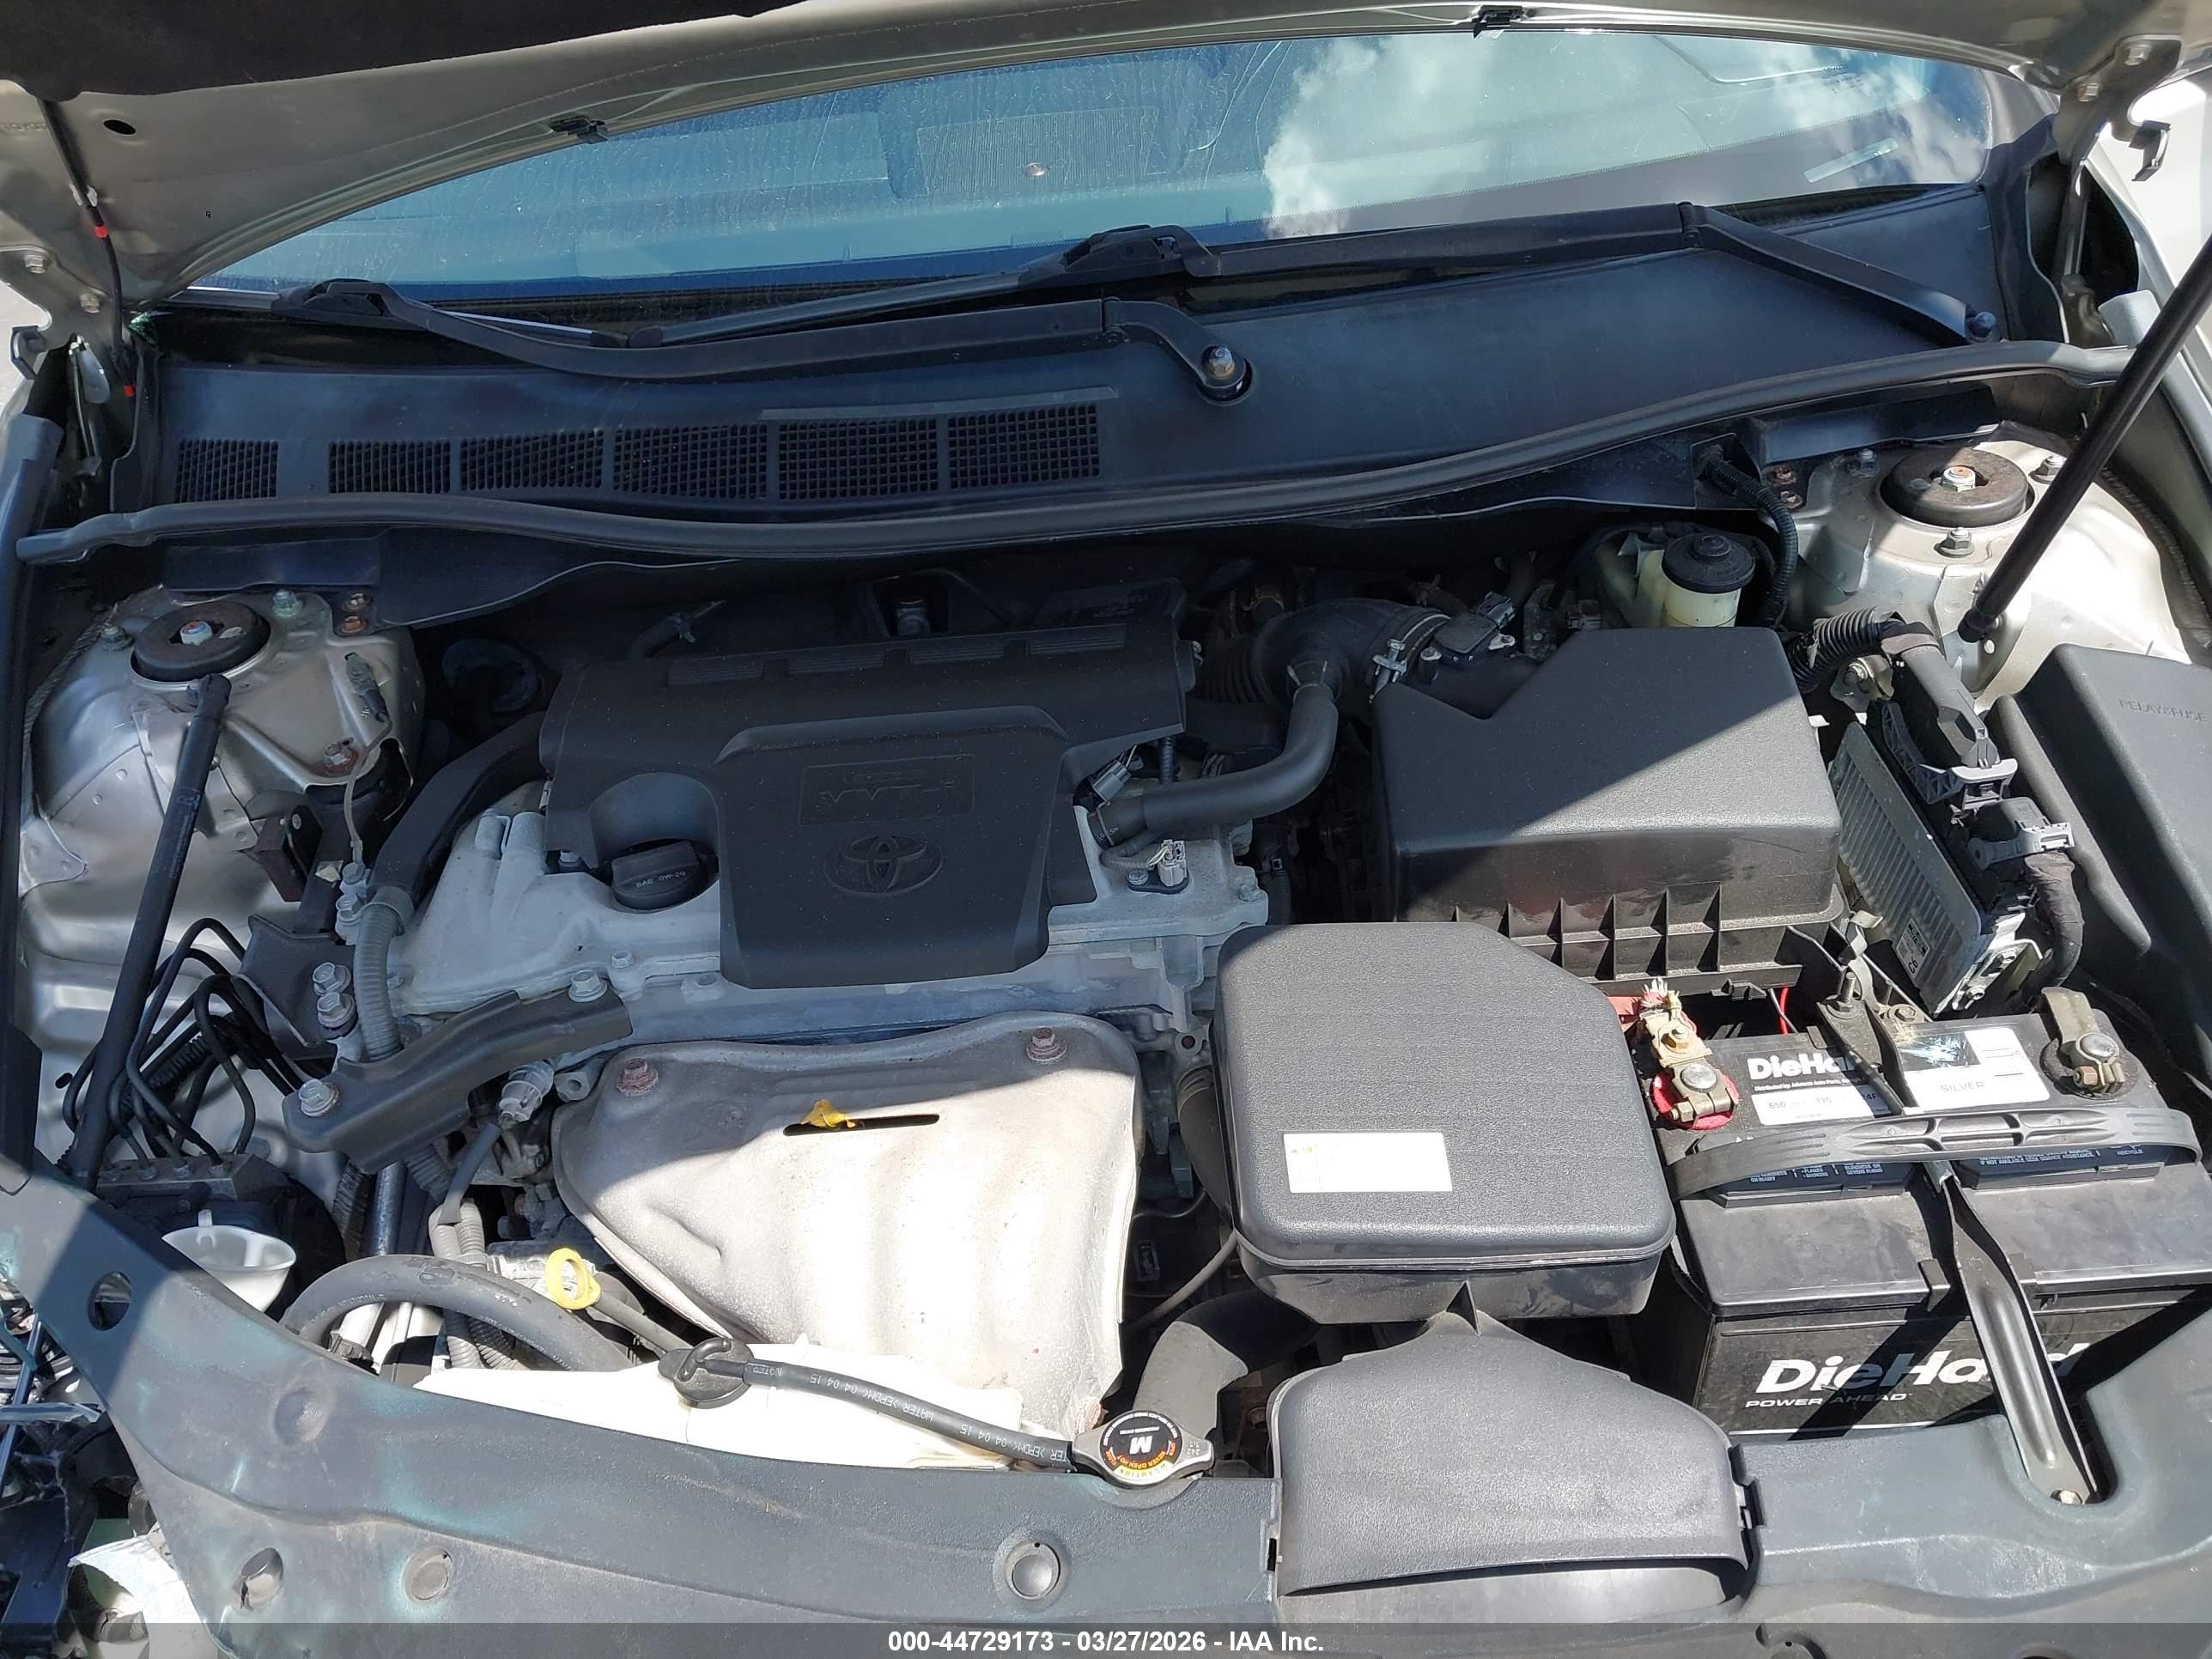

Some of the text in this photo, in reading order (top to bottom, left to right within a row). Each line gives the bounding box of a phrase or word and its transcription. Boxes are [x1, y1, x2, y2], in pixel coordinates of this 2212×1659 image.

[636, 878, 653, 888] SAE
[1747, 1053, 1855, 1080] DieHa
[1940, 1080, 1986, 1093] SILVER
[1755, 1343, 2092, 1394] DieHad
[810, 1374, 821, 1385] 15
[1744, 1393, 1908, 1408] POWER AHEAD
[902, 1402, 934, 1423] WATER
[960, 1424, 972, 1437] 15
[1129, 1435, 1153, 1455] M
[1050, 1448, 1068, 1462] TER
